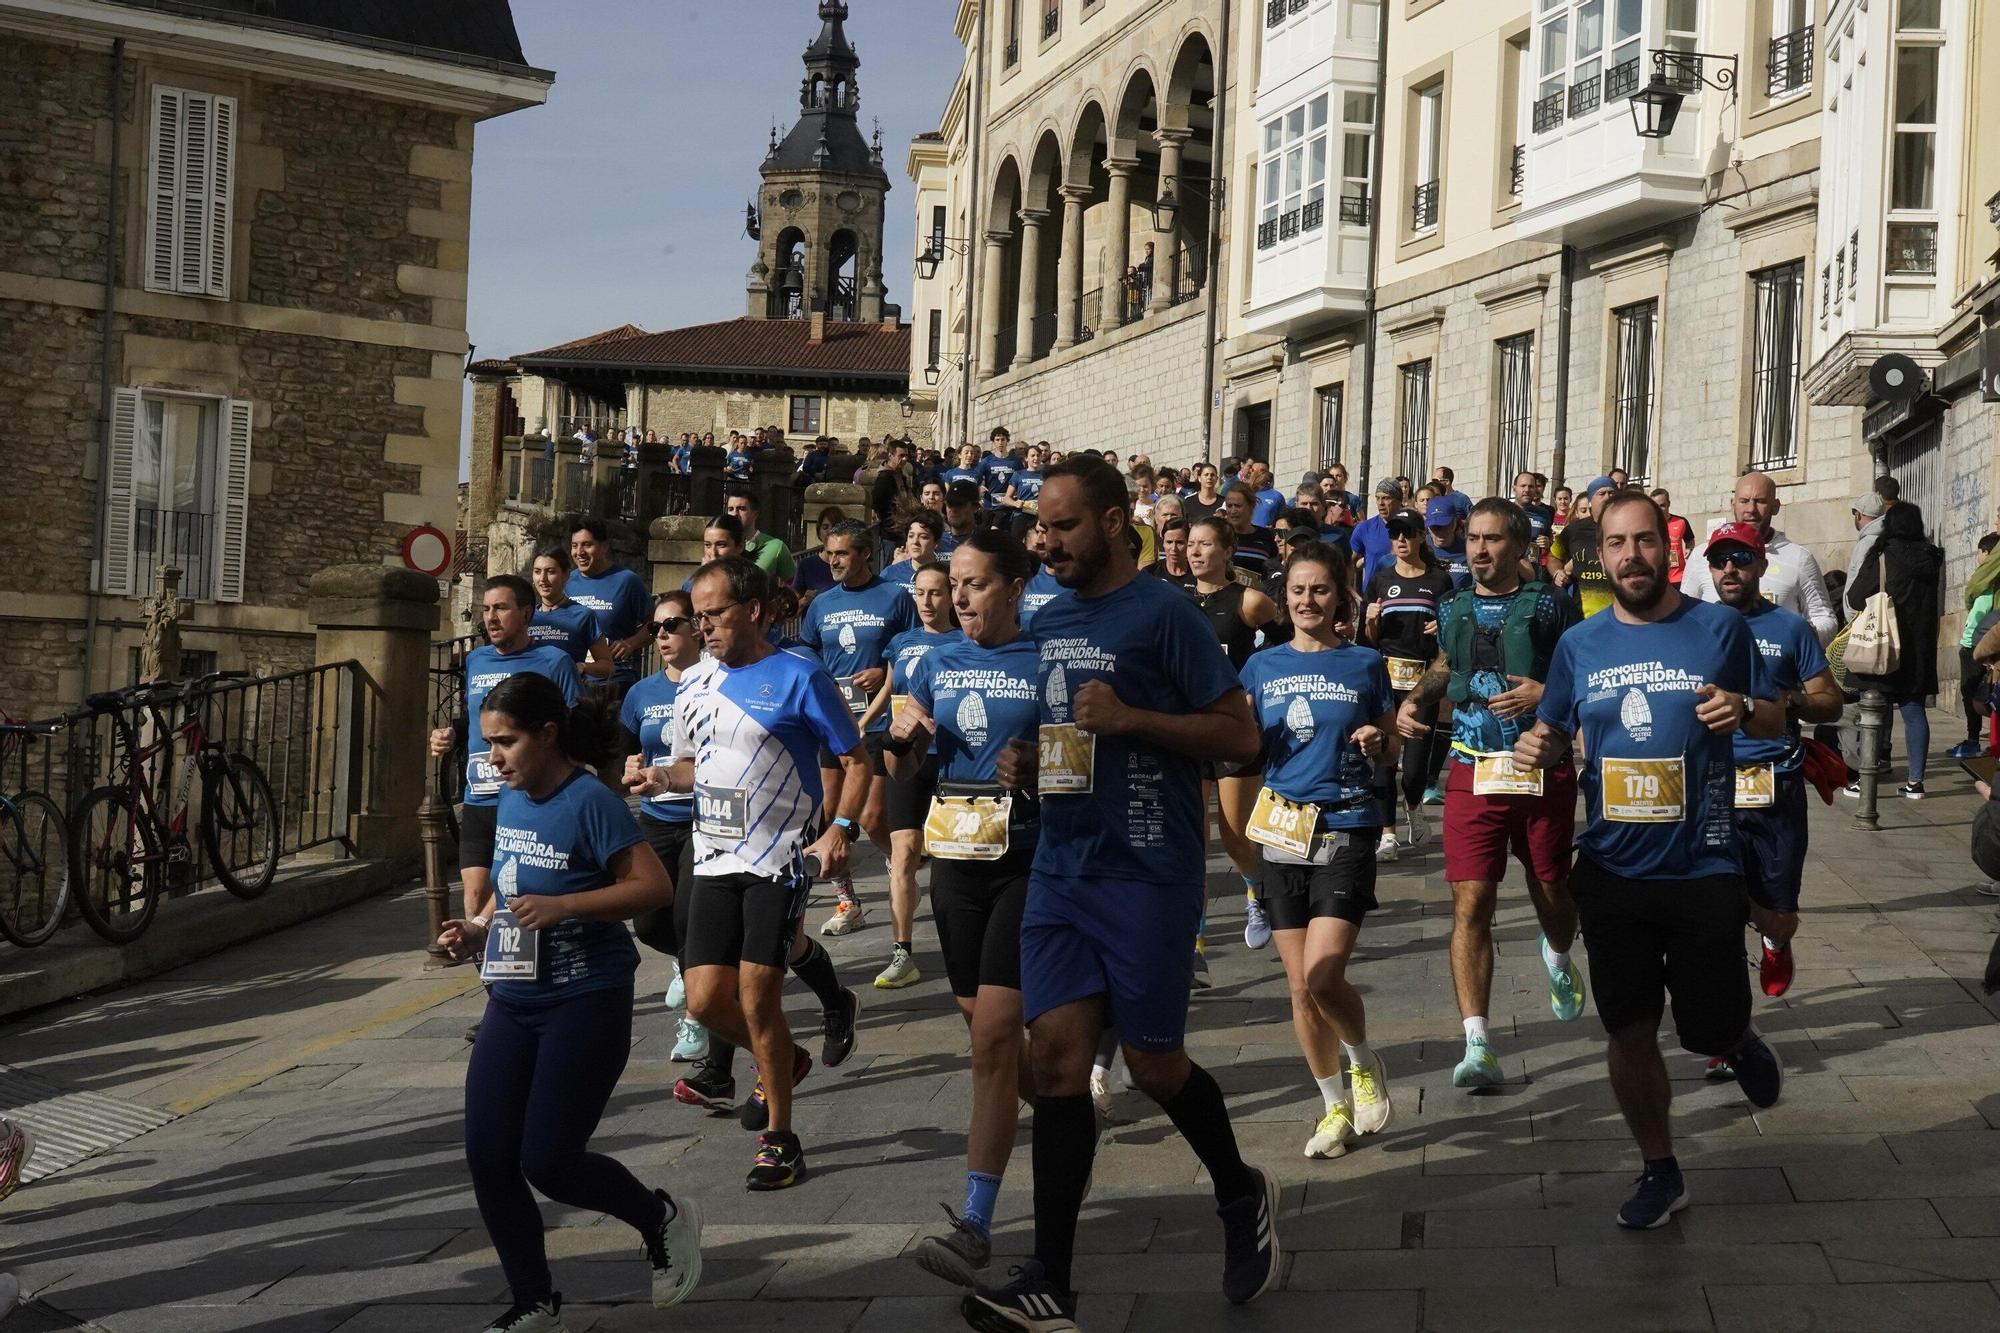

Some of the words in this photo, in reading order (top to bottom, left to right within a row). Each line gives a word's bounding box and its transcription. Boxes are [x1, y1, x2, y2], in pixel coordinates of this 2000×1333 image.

[831, 613, 876, 625] ALMENDRA
[1041, 646, 1101, 662] ALMENDRA
[1100, 653, 1117, 661] REN
[1066, 659, 1115, 672] KONKISTA
[1394, 666, 1414, 678] 320
[1588, 672, 1599, 682] LA
[1599, 661, 1664, 679] CONQUISTA
[936, 672, 945, 680] LA
[945, 669, 1006, 679] CONQUISTA
[1262, 682, 1273, 690] LA
[1272, 674, 1326, 688] CONQUISTA
[1602, 669, 1689, 690] ALMENDRA
[943, 678, 1030, 690] ALMENDRA
[1273, 682, 1346, 697] ALMENDRA
[1646, 681, 1704, 693] KONKISTA
[1310, 692, 1359, 704] KONKISTA
[1623, 775, 1659, 799] 179
[699, 796, 732, 820] 1044
[1268, 805, 1299, 832] 613
[499, 826, 538, 842] CONQUISTA
[497, 837, 555, 859] ALMENDRA
[554, 851, 570, 860] REN
[519, 854, 569, 870] KONKISTA
[498, 926, 521, 952] 782
